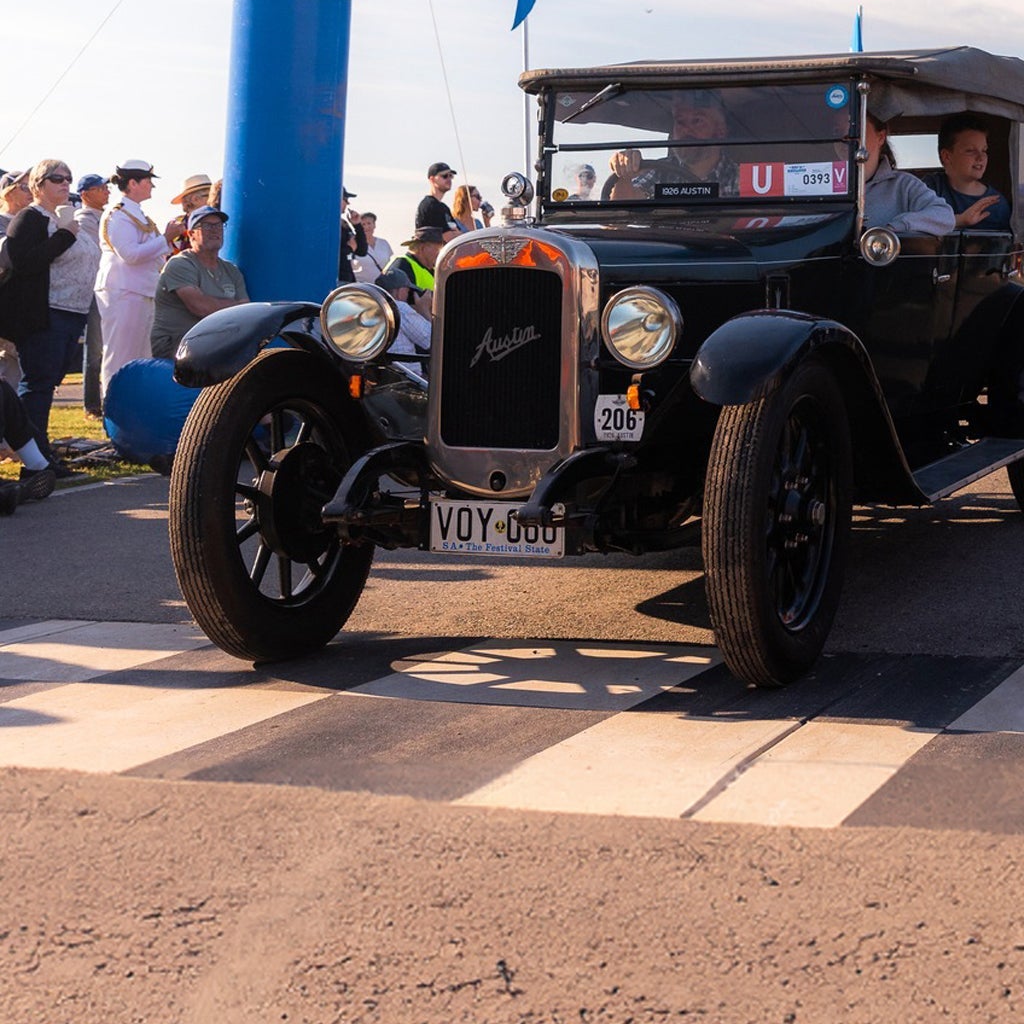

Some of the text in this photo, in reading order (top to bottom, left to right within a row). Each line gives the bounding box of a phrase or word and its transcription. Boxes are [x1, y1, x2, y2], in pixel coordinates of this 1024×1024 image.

[752, 165, 773, 194] U
[803, 172, 831, 185] 0393
[834, 167, 846, 183] V
[680, 187, 711, 195] AUSTIN
[469, 325, 541, 368] Austin
[601, 407, 637, 431] 206
[437, 506, 494, 543] VOY
[466, 543, 483, 551] The
[485, 543, 522, 552] Festival
[525, 545, 550, 554] State
